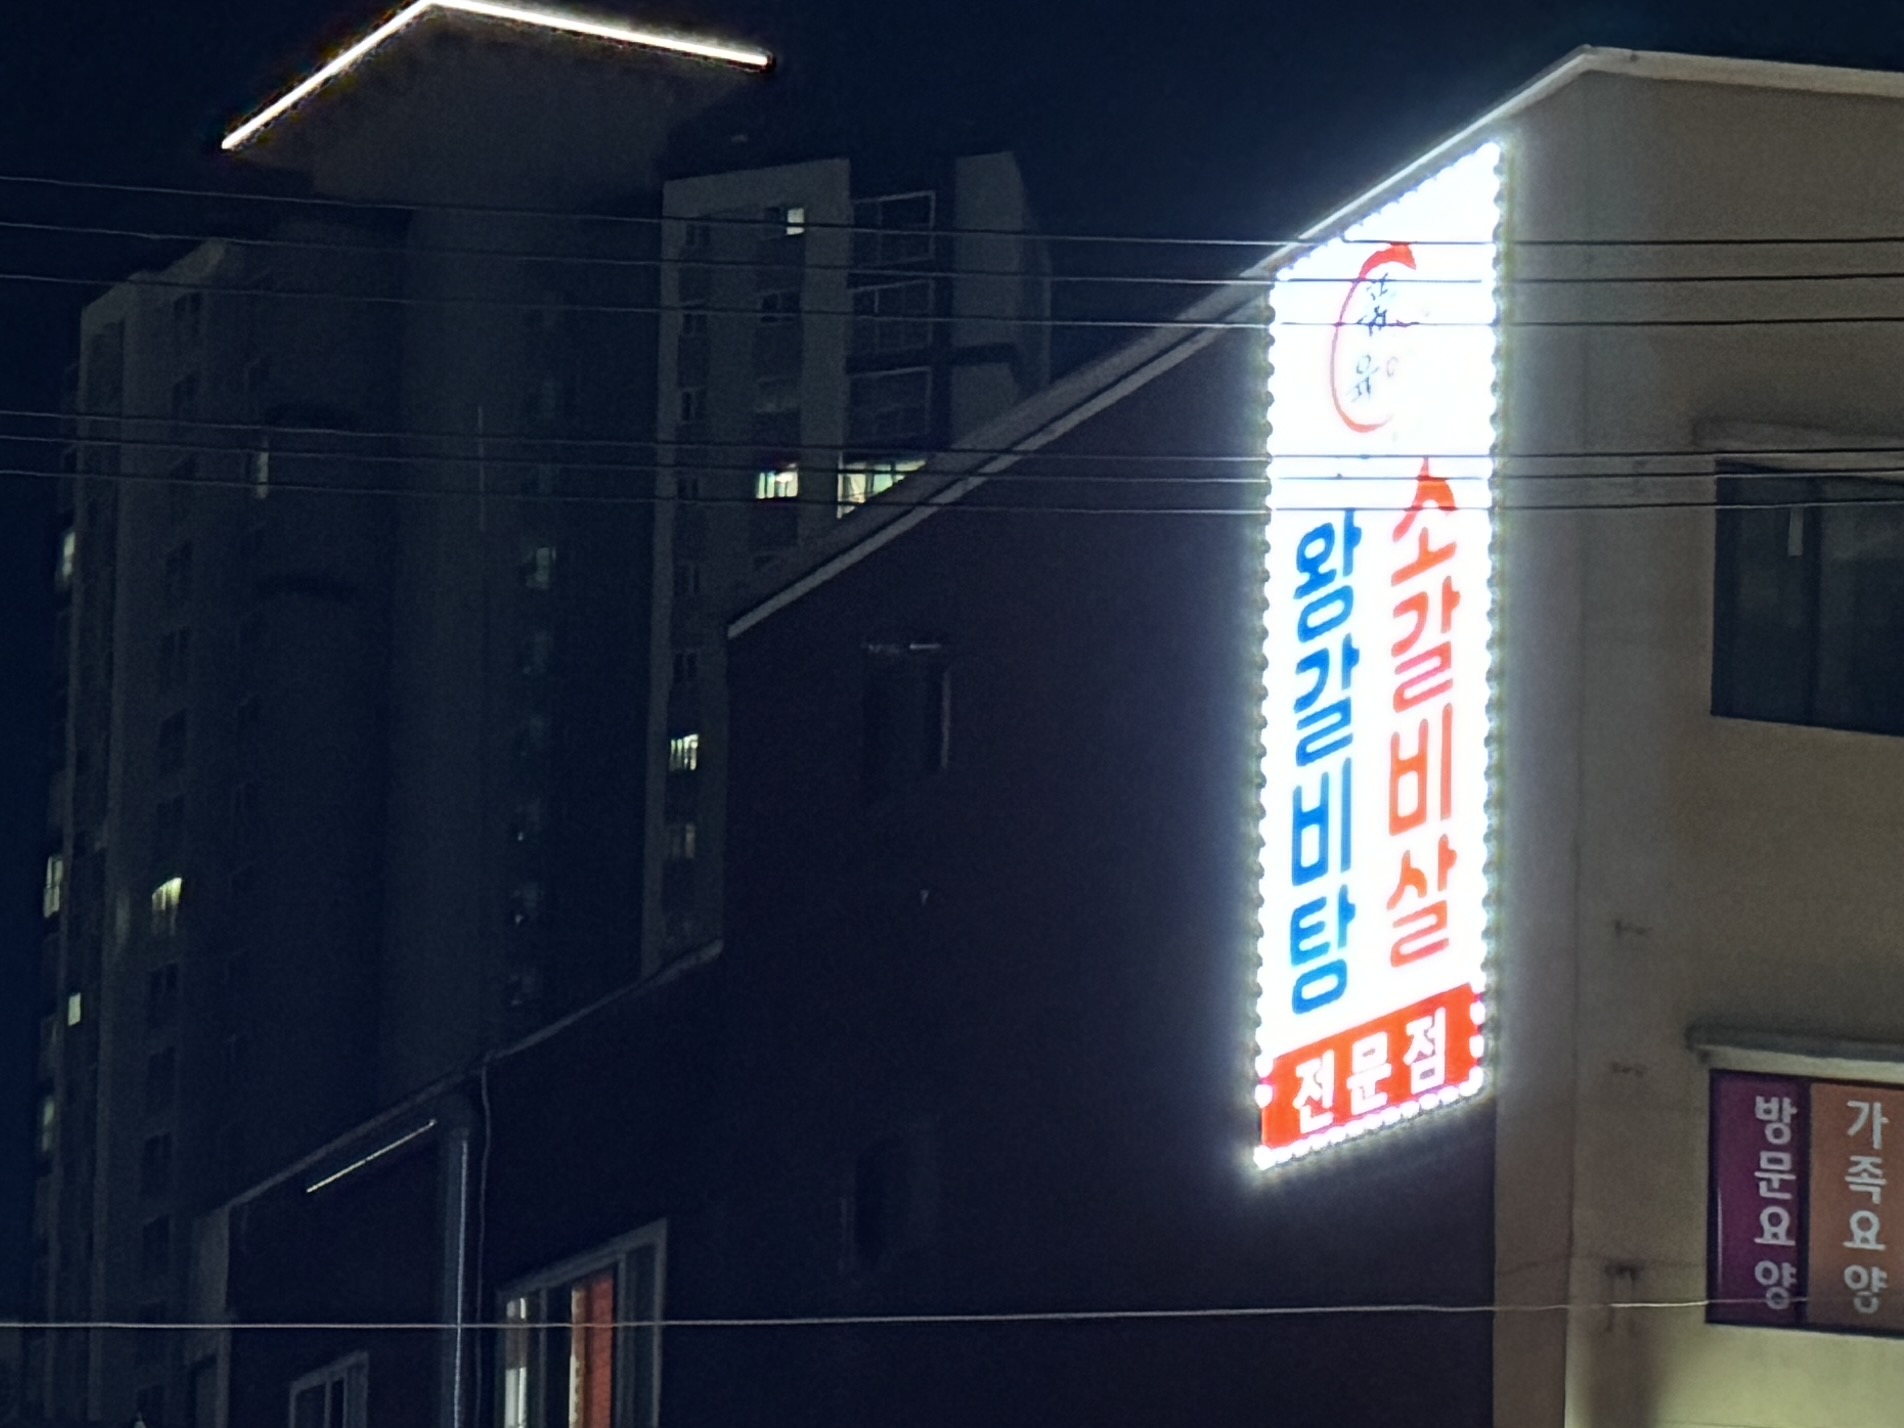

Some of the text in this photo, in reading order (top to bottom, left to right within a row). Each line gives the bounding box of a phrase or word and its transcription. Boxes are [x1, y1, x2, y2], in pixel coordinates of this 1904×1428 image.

[1289, 508, 1362, 1016] 왕갈비탕
[1386, 457, 1462, 973] 소갈비살
[1291, 1006, 1449, 1136] 전문점
[1754, 1096, 1798, 1311] 방문요양
[1842, 1099, 1890, 1315] 가족요양
